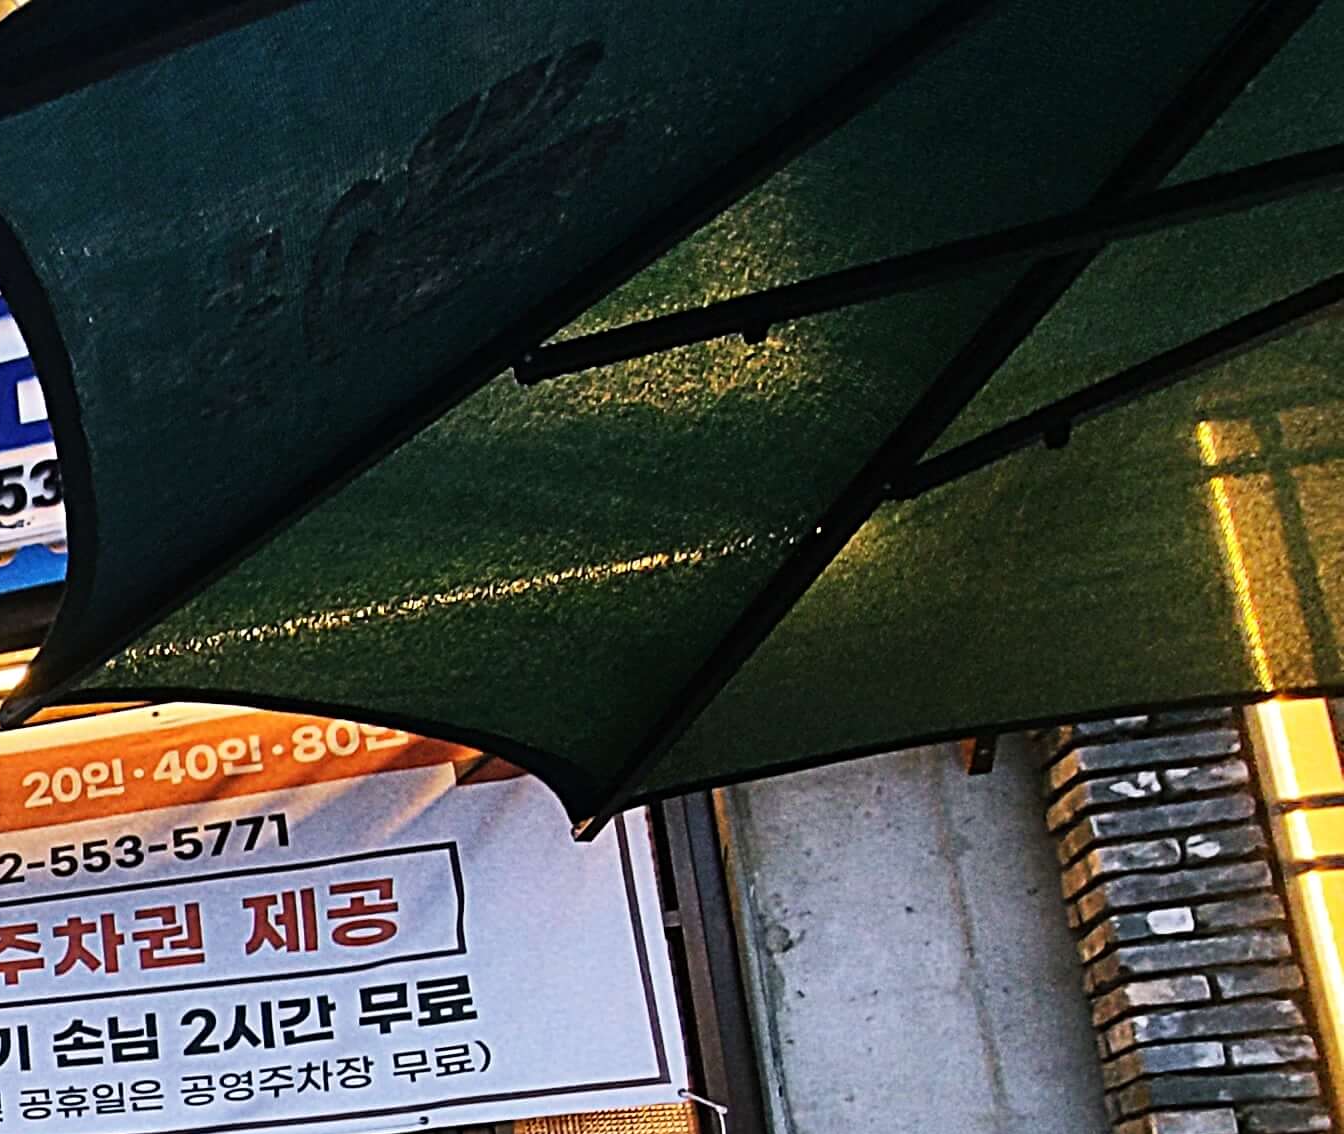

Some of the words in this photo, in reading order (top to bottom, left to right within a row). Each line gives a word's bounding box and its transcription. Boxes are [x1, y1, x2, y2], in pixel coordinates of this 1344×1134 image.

[244, 877, 400, 955] 제공
[52, 1012, 160, 1069] 손님
[180, 995, 336, 1057] 2시간
[358, 975, 480, 1036] 무료
[18, 1079, 165, 1121] 공휴일은
[180, 1053, 374, 1107] 공영주차장
[392, 1040, 493, 1084] 무료)
